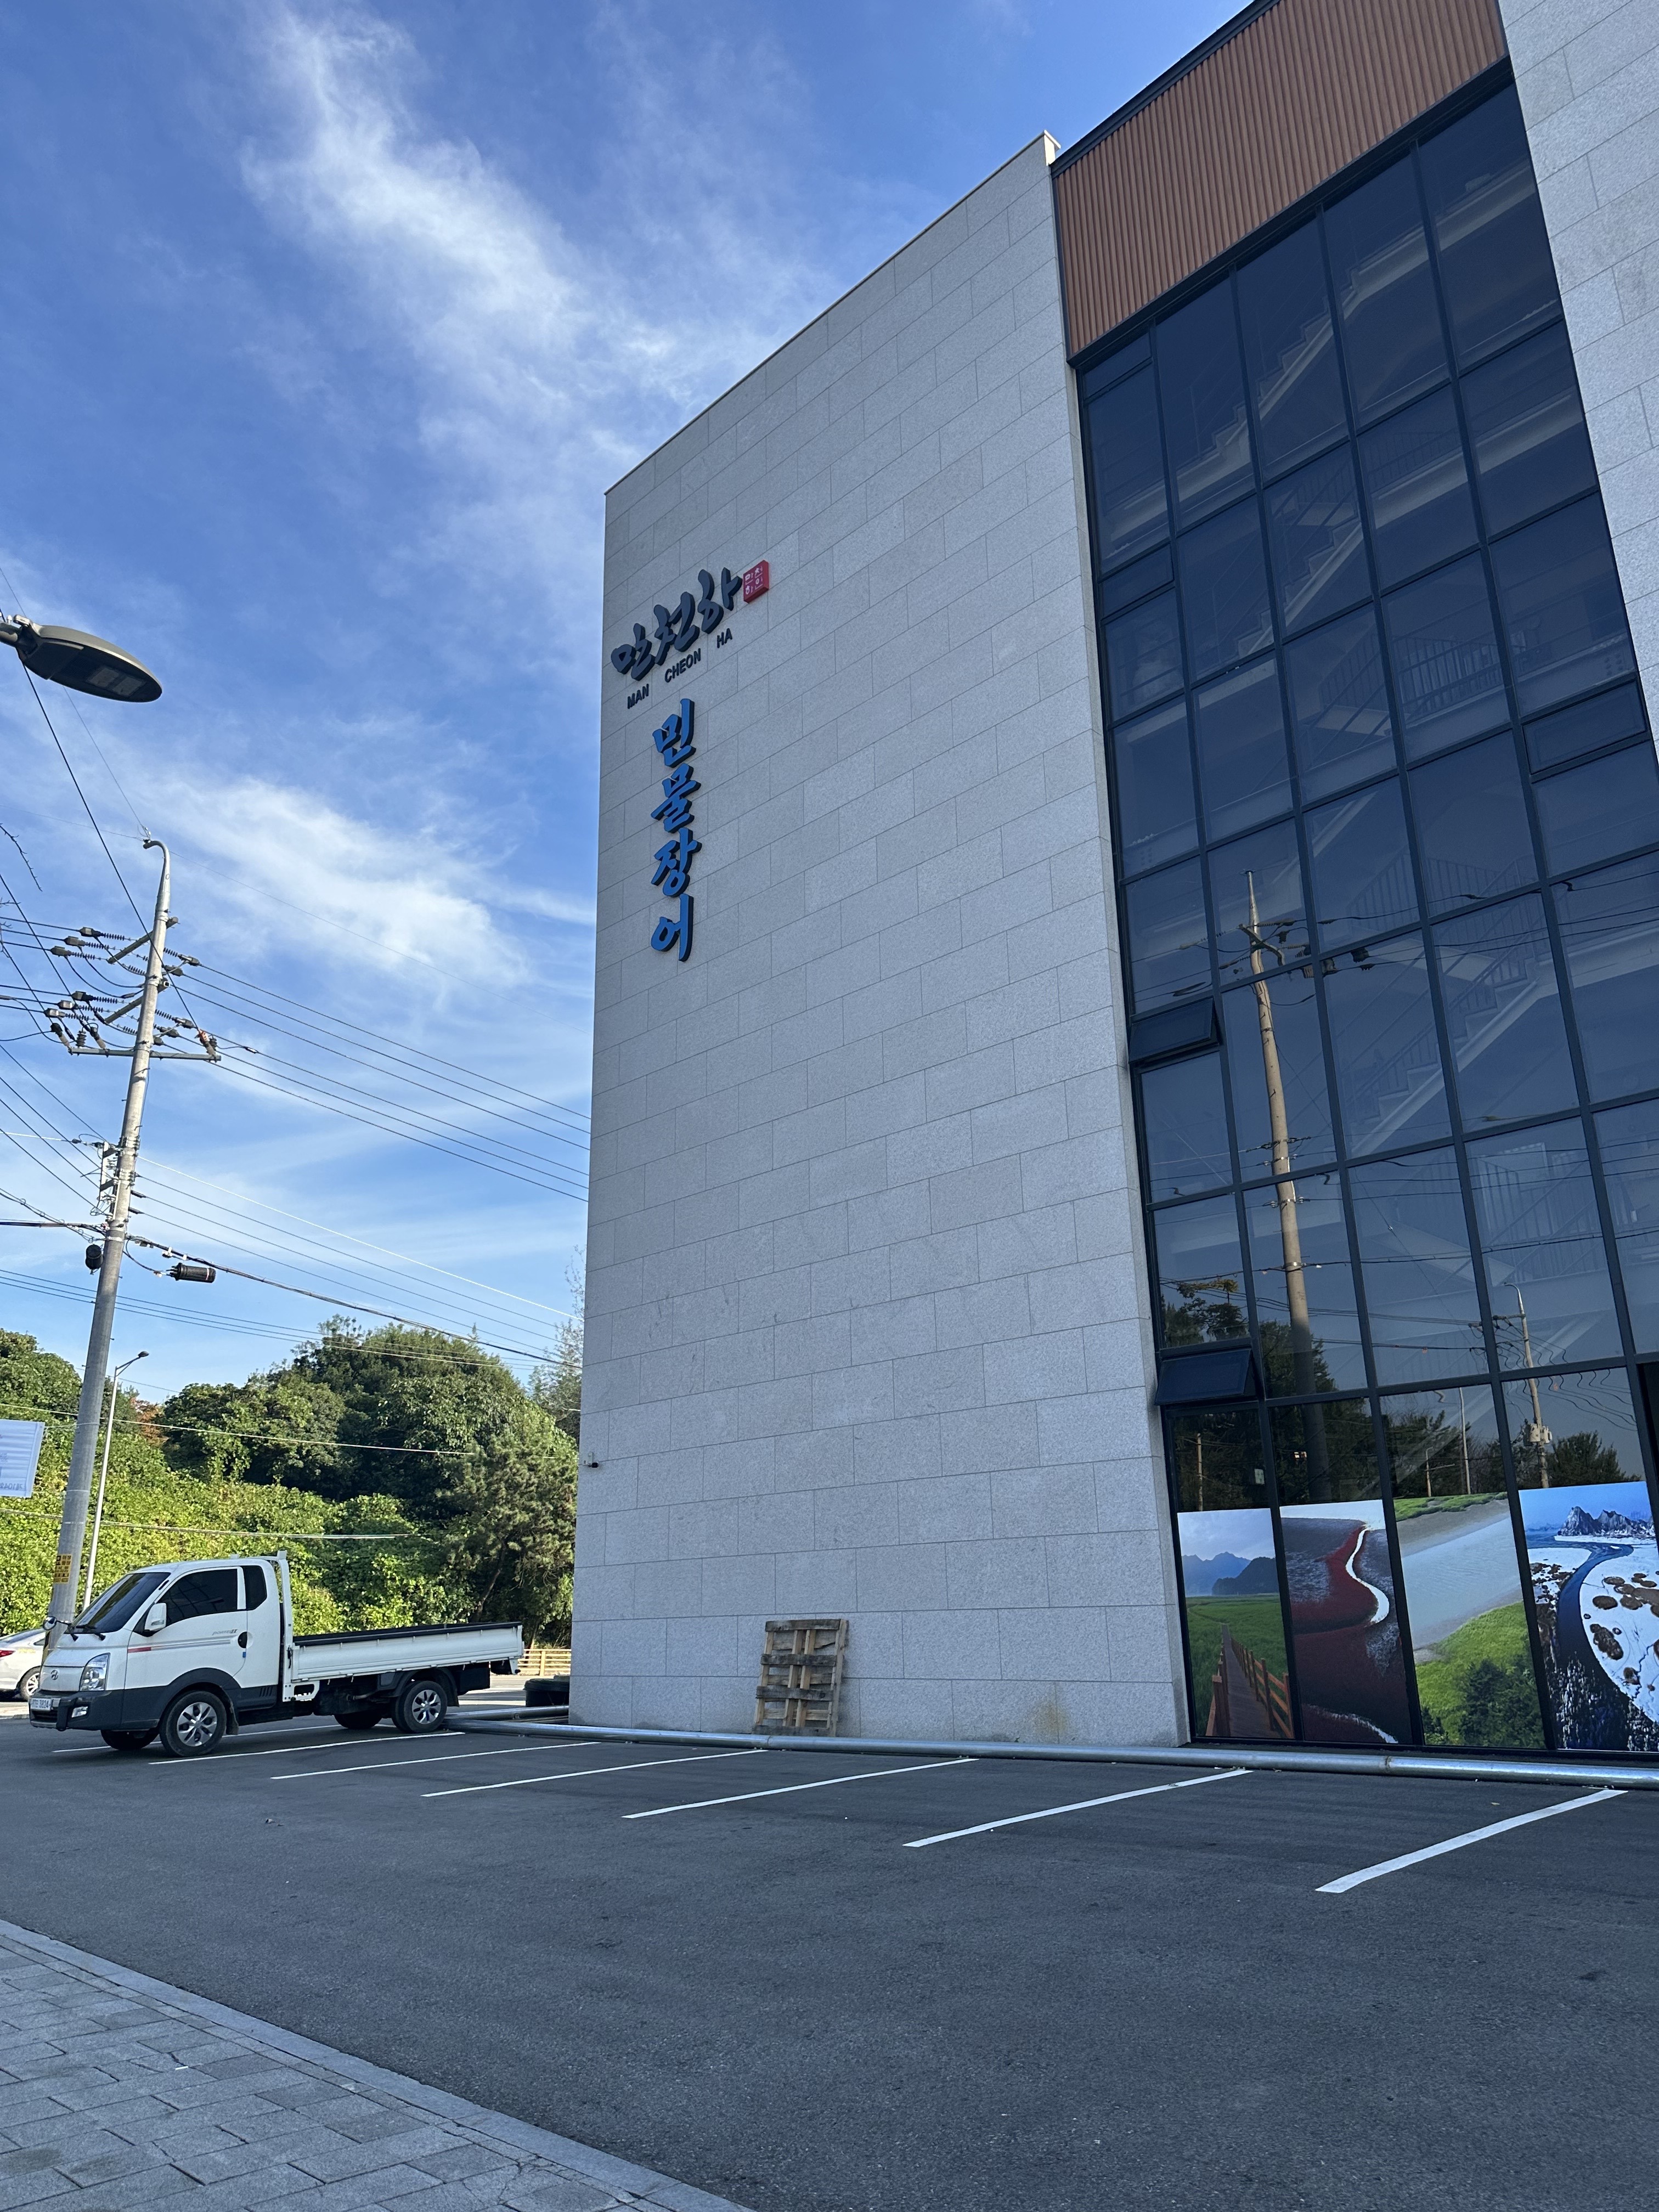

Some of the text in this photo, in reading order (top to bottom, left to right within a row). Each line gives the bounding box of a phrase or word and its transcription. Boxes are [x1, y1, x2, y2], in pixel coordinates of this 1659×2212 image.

[611, 567, 743, 681] 만천하
[627, 628, 732, 709] MAN CHEON HA
[651, 698, 702, 962] 민물장어
